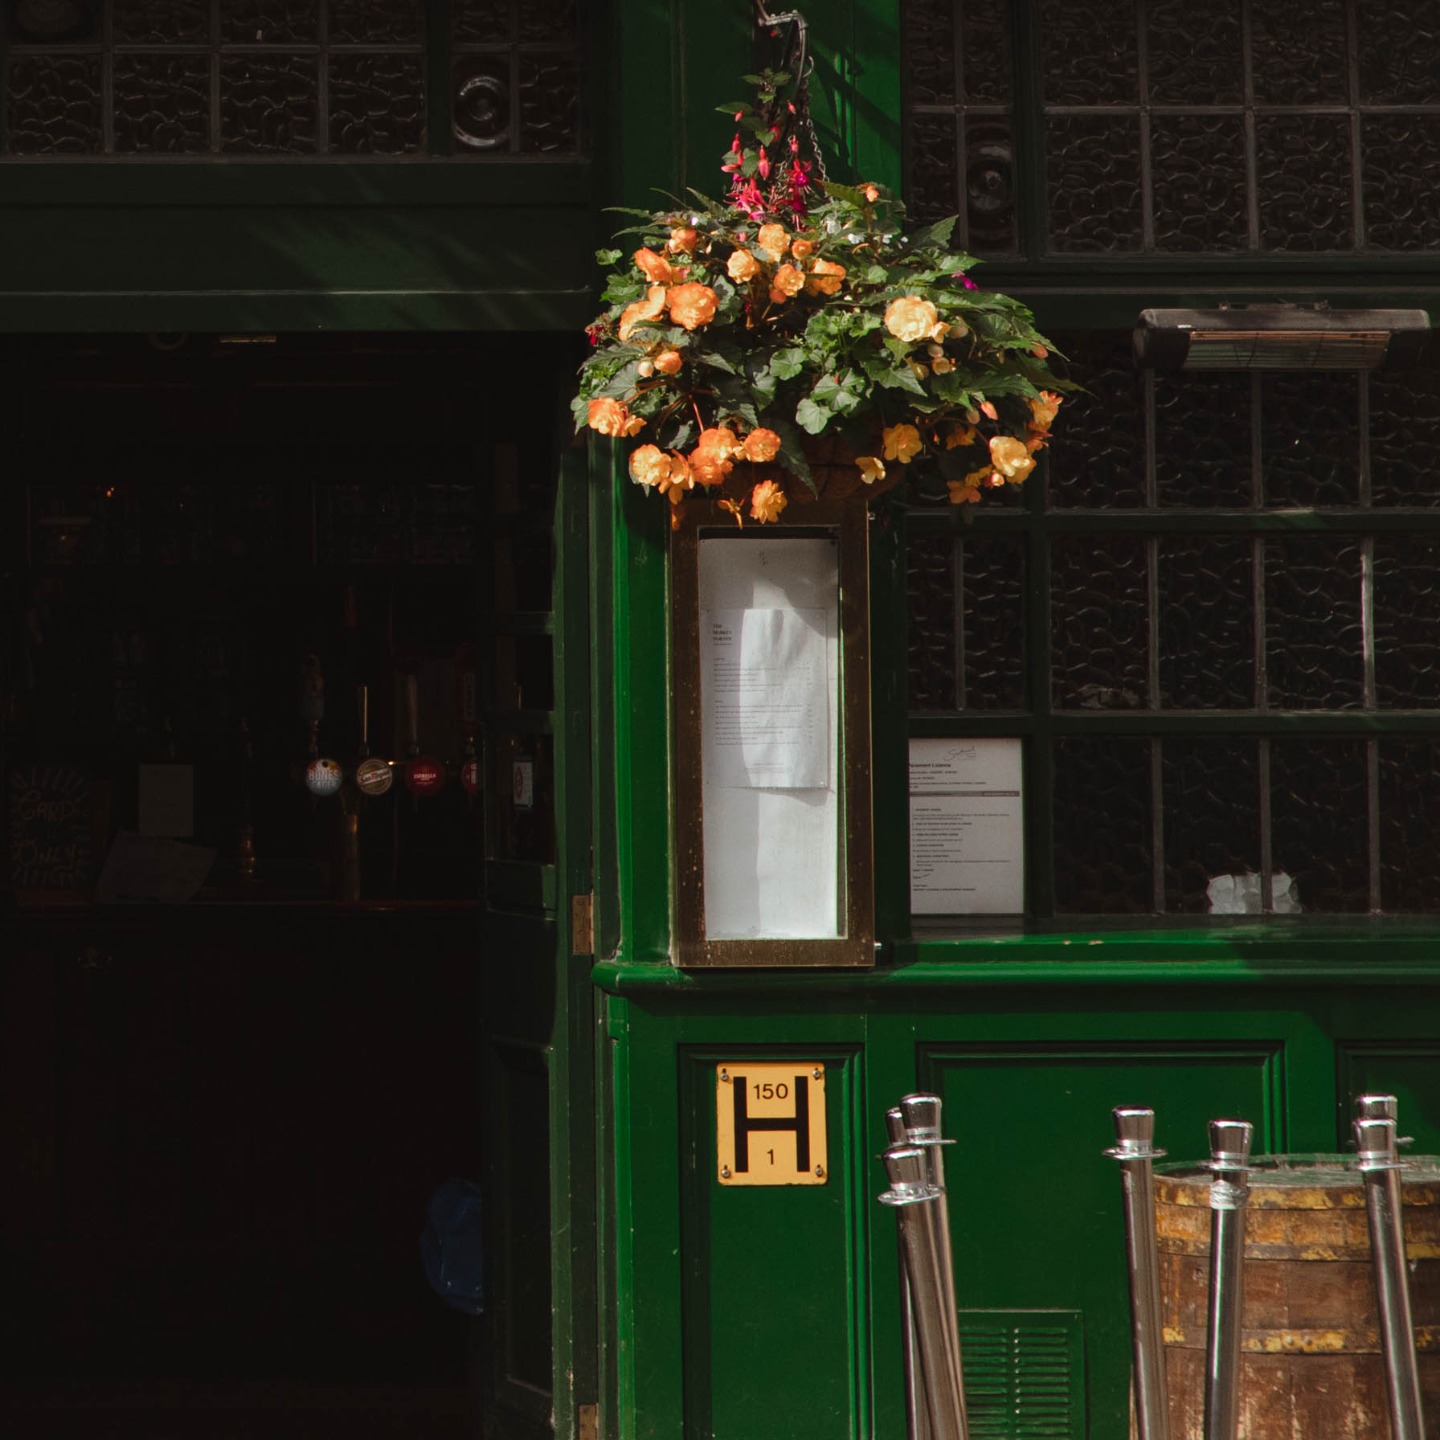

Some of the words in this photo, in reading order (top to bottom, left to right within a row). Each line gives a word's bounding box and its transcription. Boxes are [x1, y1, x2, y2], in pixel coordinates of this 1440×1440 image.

[753, 1083, 789, 1100] 150
[733, 1076, 811, 1173] H
[766, 1149, 775, 1165] 1
